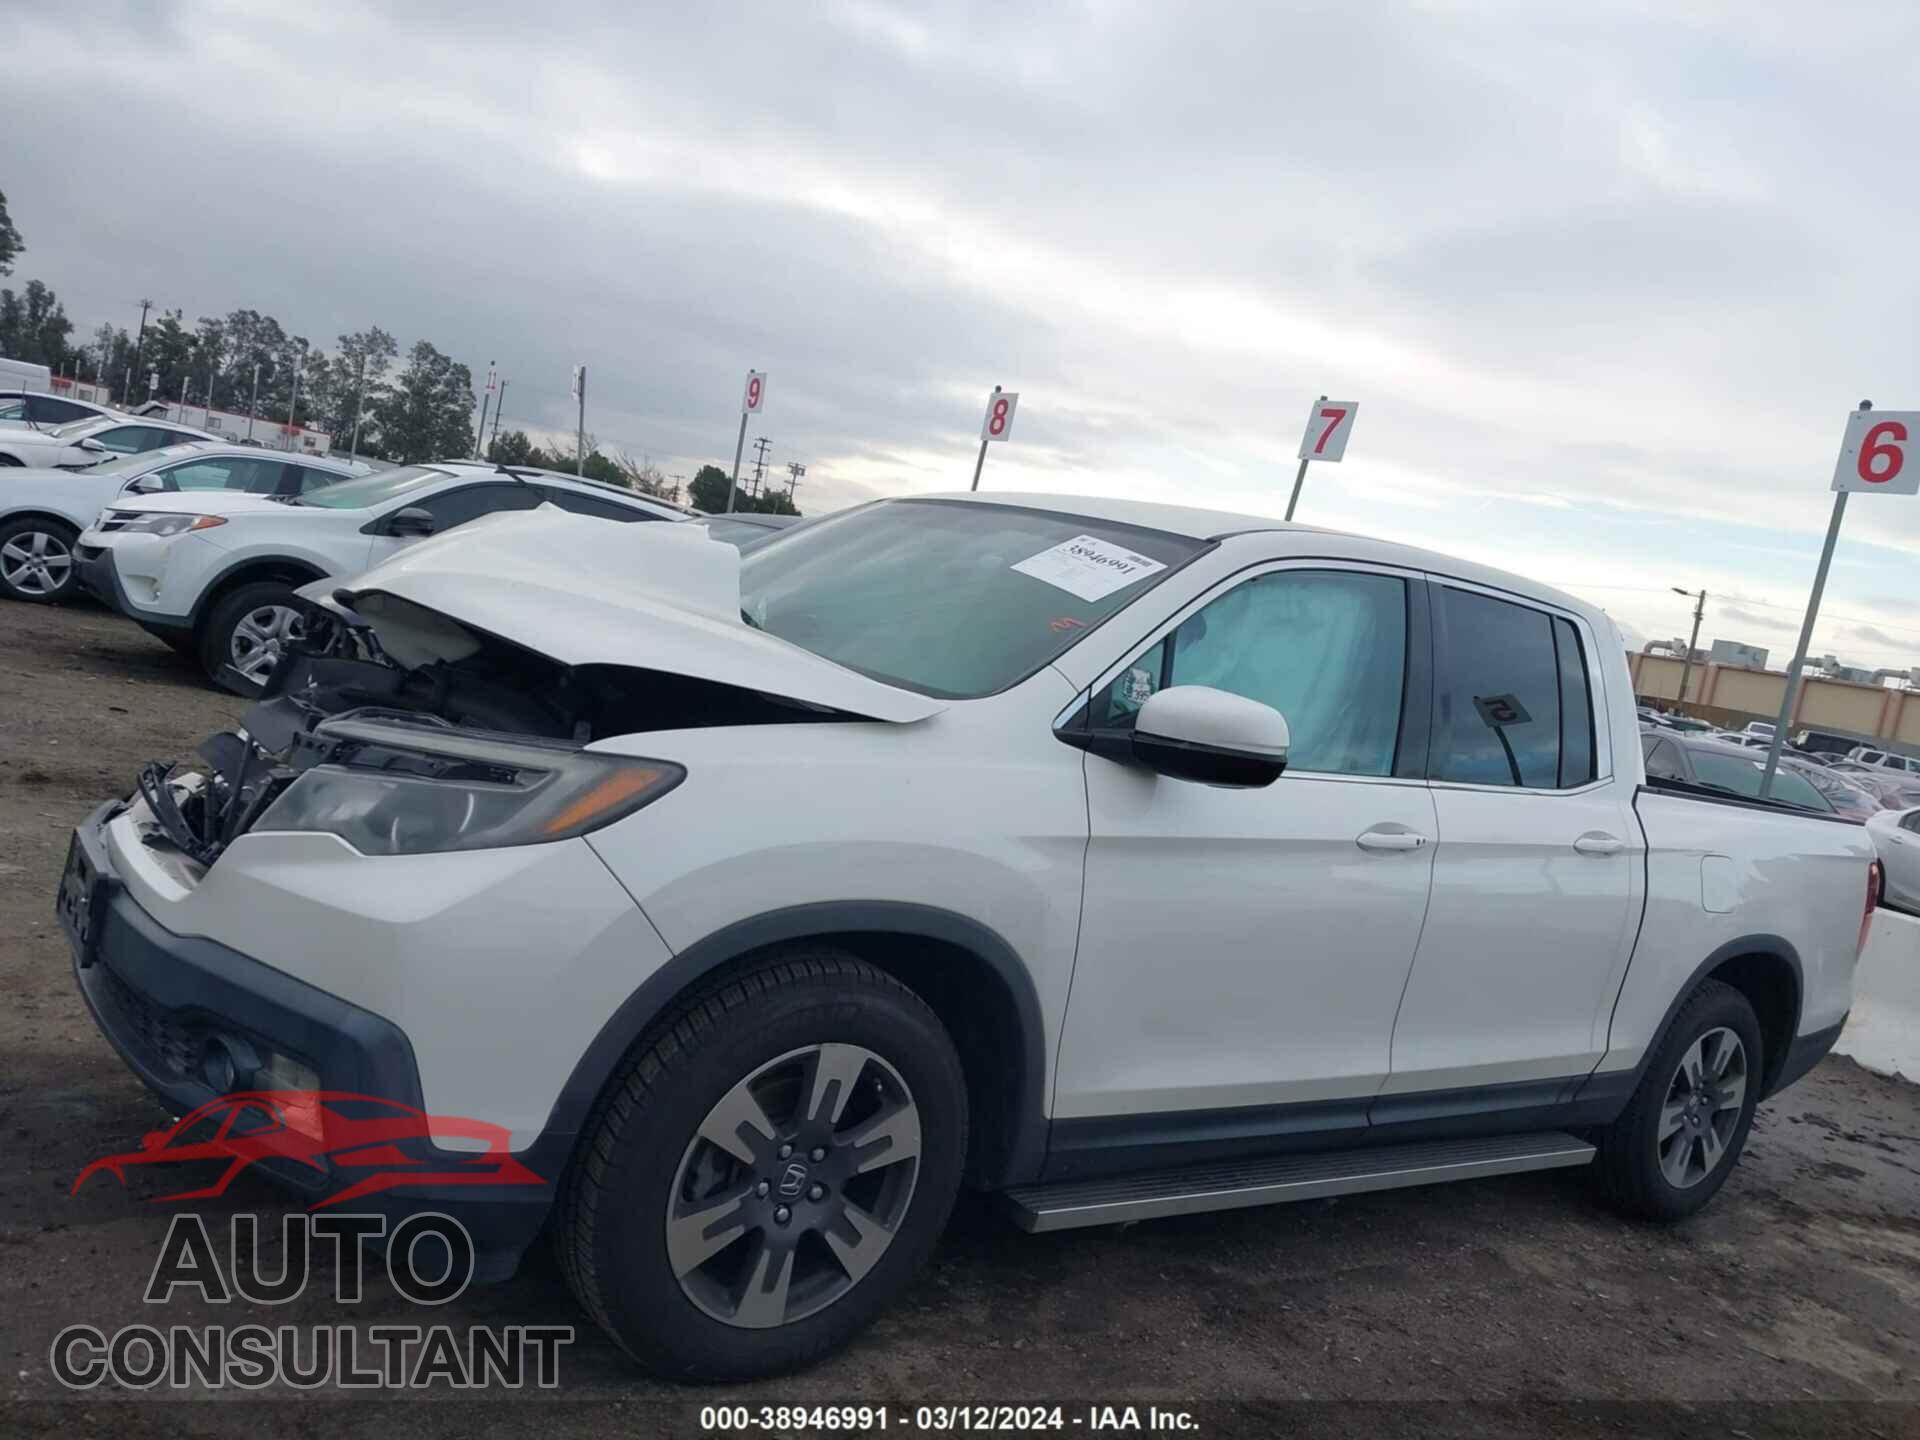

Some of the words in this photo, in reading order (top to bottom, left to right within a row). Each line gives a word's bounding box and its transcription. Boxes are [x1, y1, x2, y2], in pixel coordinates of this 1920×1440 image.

[748, 378, 760, 408] 9
[989, 399, 1009, 435] 8
[1314, 408, 1346, 454] 7
[1857, 421, 1907, 483] 6
